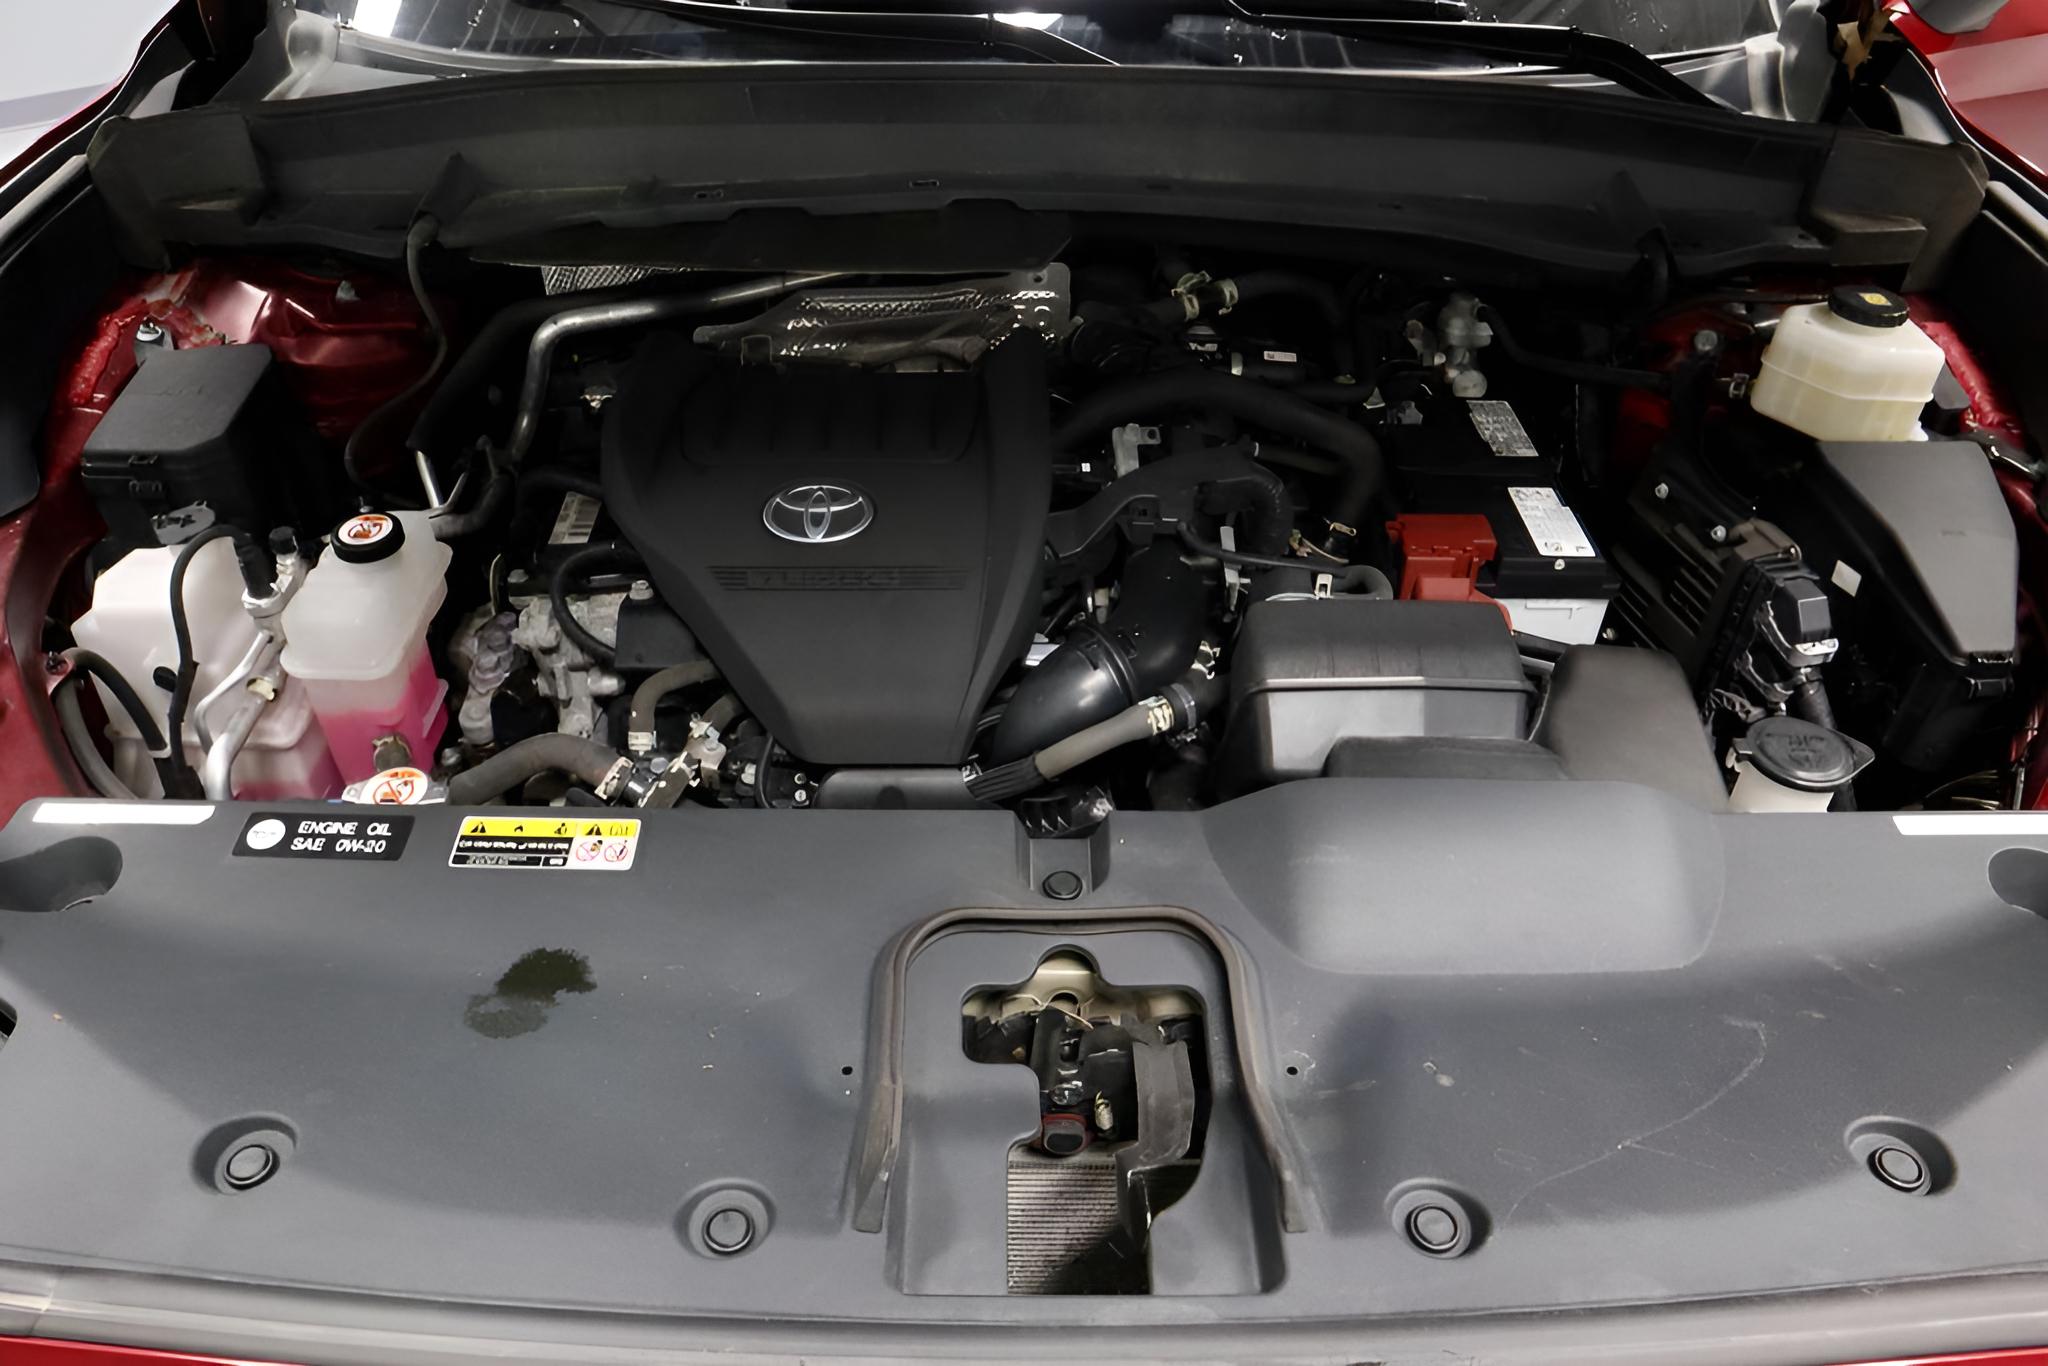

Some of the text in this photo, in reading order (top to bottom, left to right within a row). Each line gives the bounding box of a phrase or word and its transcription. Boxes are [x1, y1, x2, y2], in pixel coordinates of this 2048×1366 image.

[297, 820, 392, 837] ENGINE OIL
[290, 836, 326, 852] SAE
